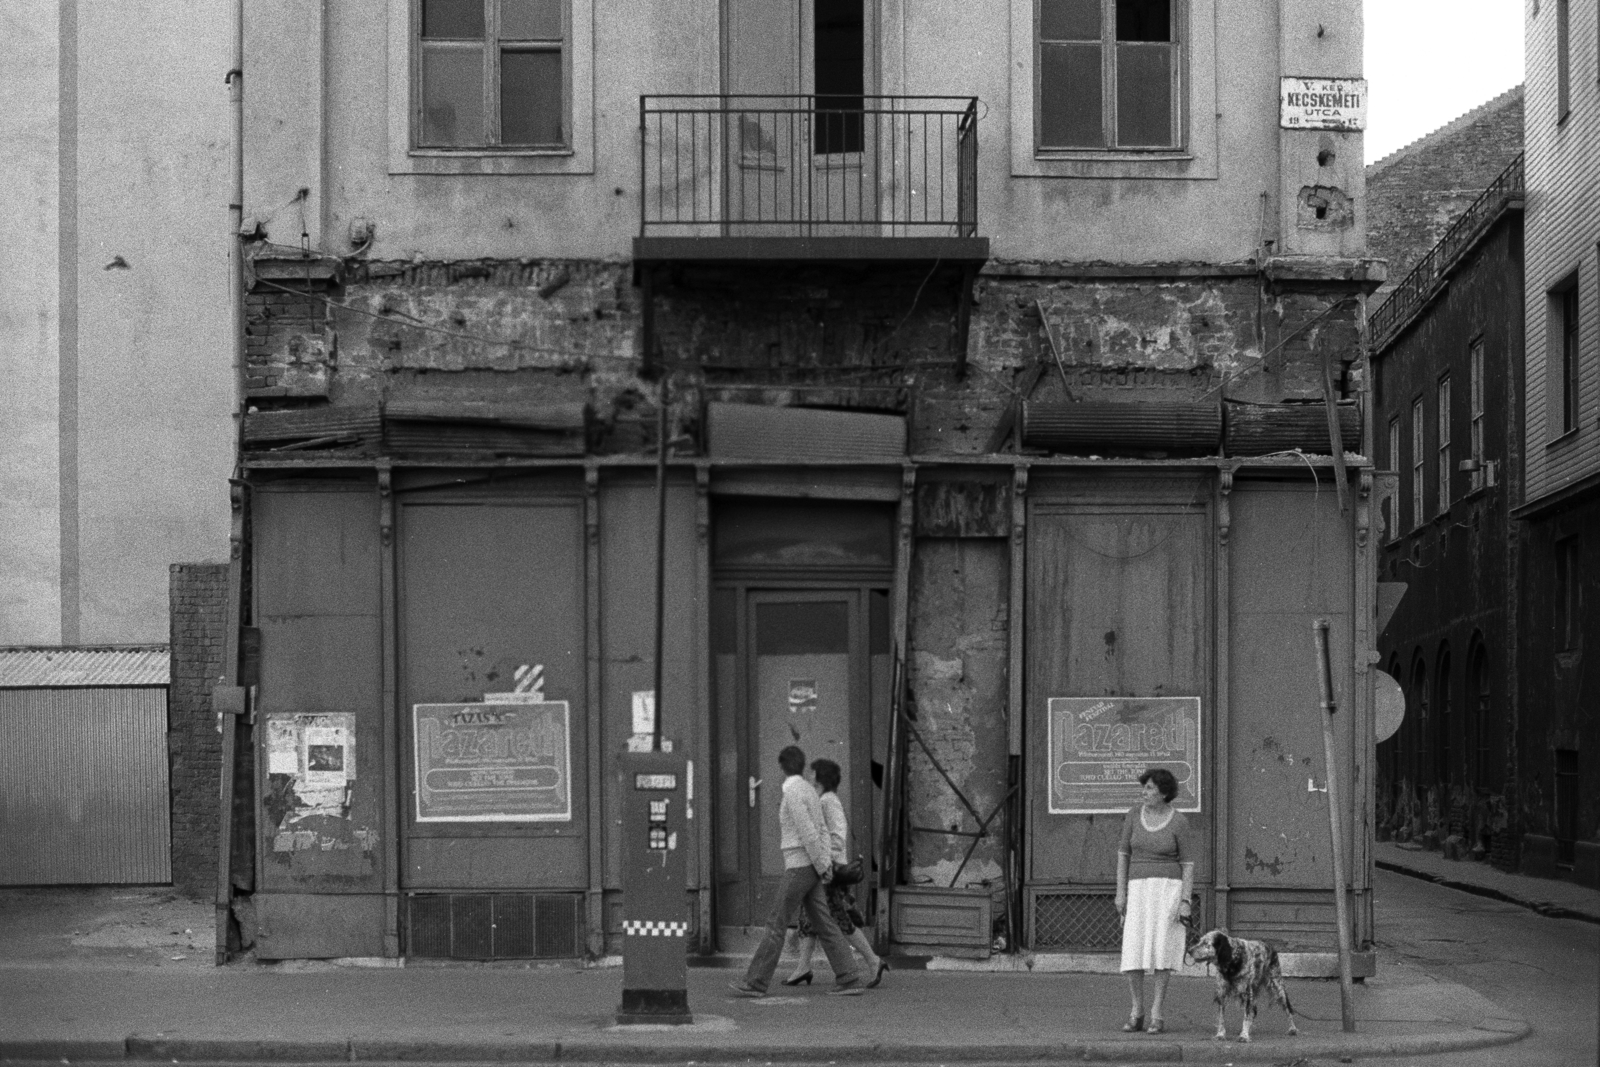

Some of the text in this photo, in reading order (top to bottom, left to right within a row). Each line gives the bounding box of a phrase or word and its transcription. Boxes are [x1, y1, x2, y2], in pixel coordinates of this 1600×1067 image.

[1303, 82, 1316, 91] V.
[1305, 109, 1342, 117] UTCA
[1288, 117, 1300, 125] 19
